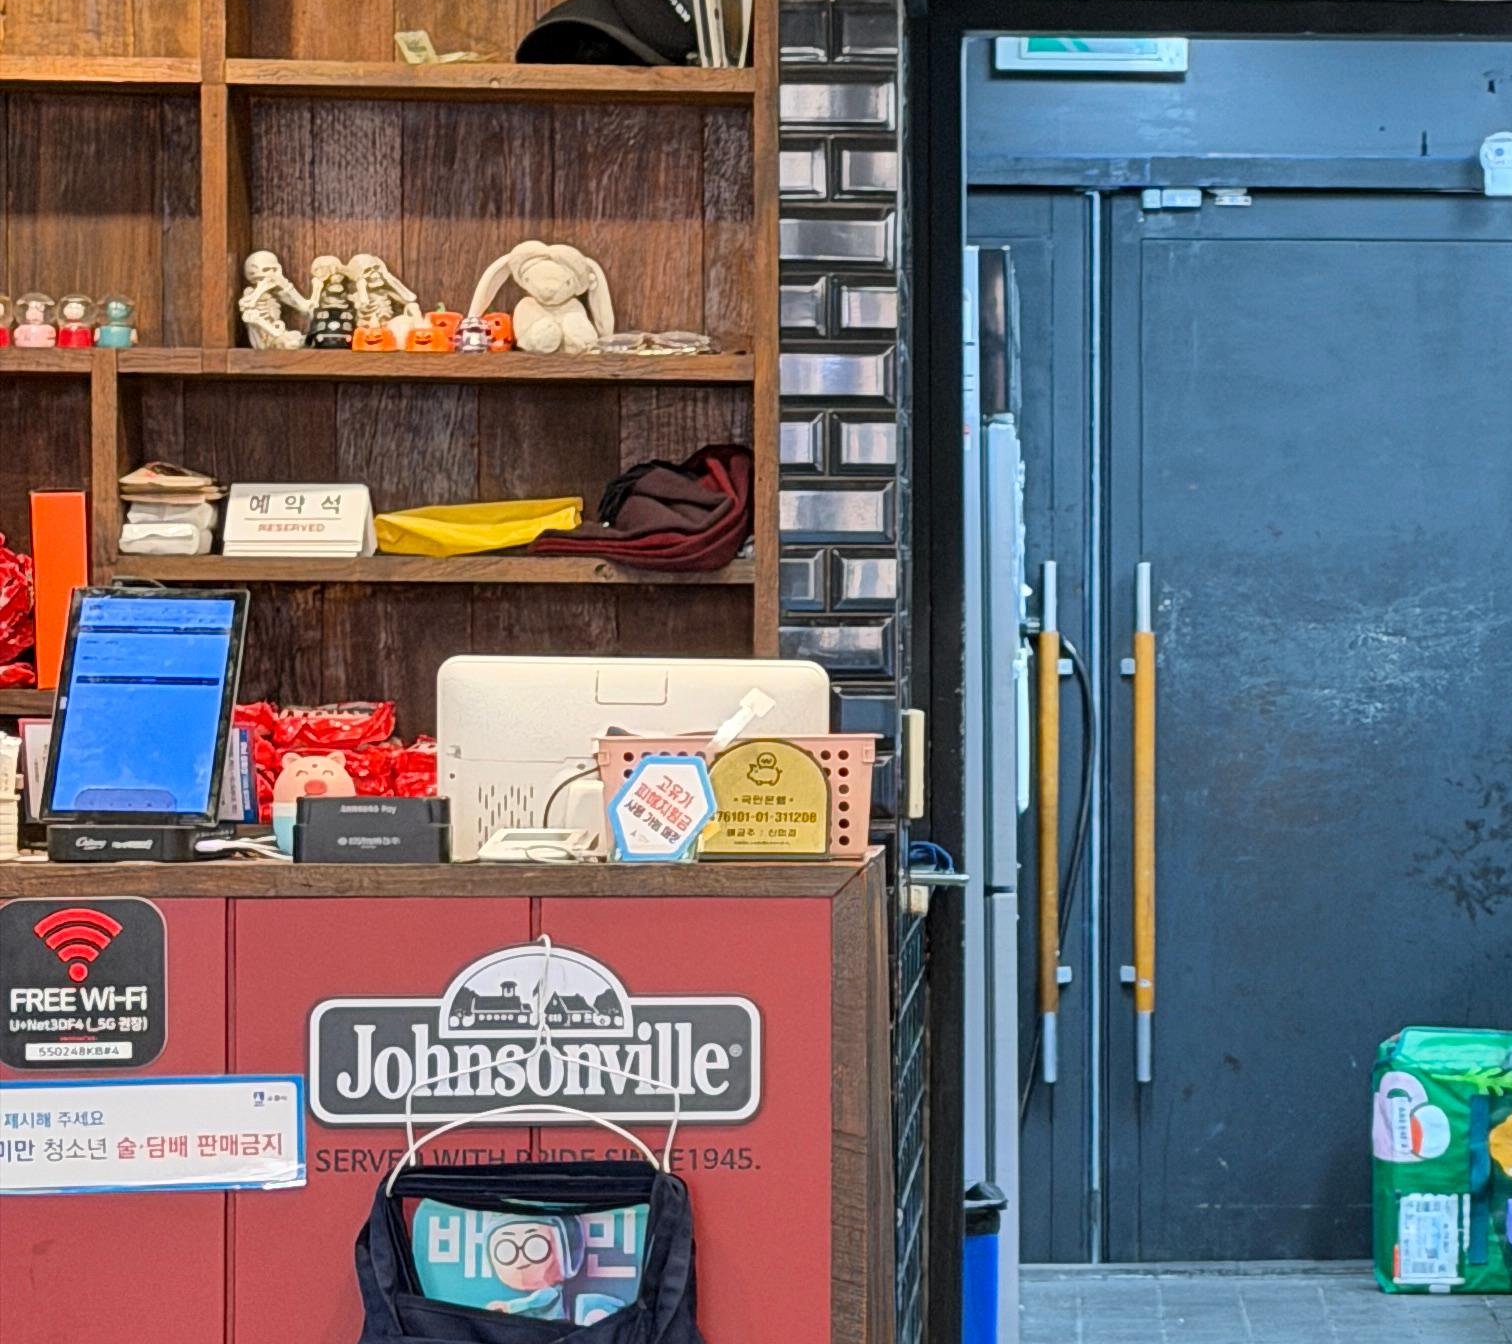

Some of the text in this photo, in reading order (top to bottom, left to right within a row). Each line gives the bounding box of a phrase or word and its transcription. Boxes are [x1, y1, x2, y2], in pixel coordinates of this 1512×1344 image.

[258, 523, 325, 532] RESERVED
[657, 775, 694, 809] 고유가
[10, 986, 147, 1012] FREE Wi-Fi
[336, 1021, 730, 1100] Johnsonville
[4, 1110, 104, 1129] 제시해 주세요
[43, 1137, 107, 1161] 청소년
[117, 1135, 188, 1160] 술·담배
[197, 1133, 283, 1157] 판매금지
